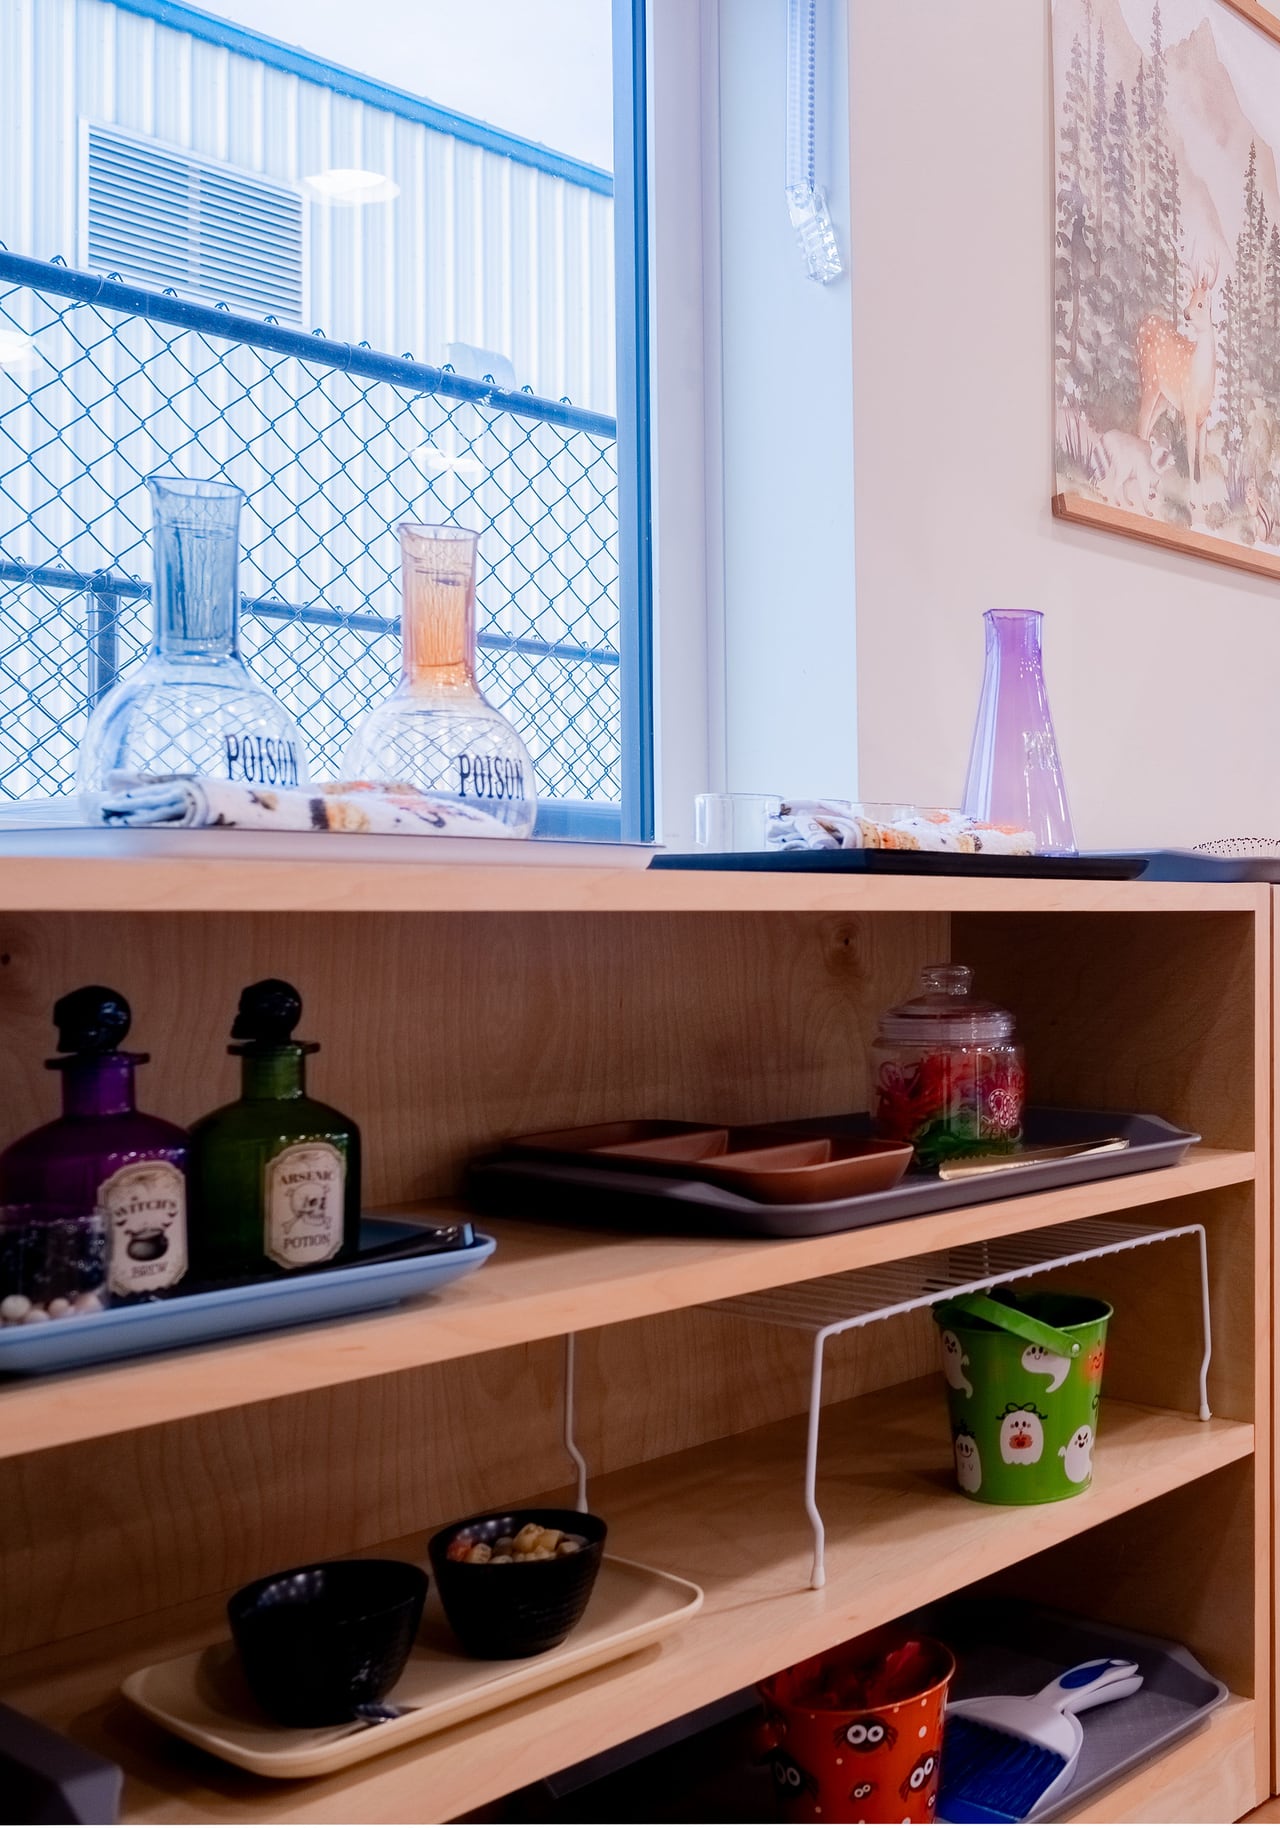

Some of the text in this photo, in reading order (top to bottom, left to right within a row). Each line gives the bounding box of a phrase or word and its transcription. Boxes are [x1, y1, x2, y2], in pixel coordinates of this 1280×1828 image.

[225, 734, 299, 786] POISON
[458, 754, 525, 800] POISON
[281, 1171, 333, 1185] ARSENIC
[283, 1233, 331, 1250] POTION
